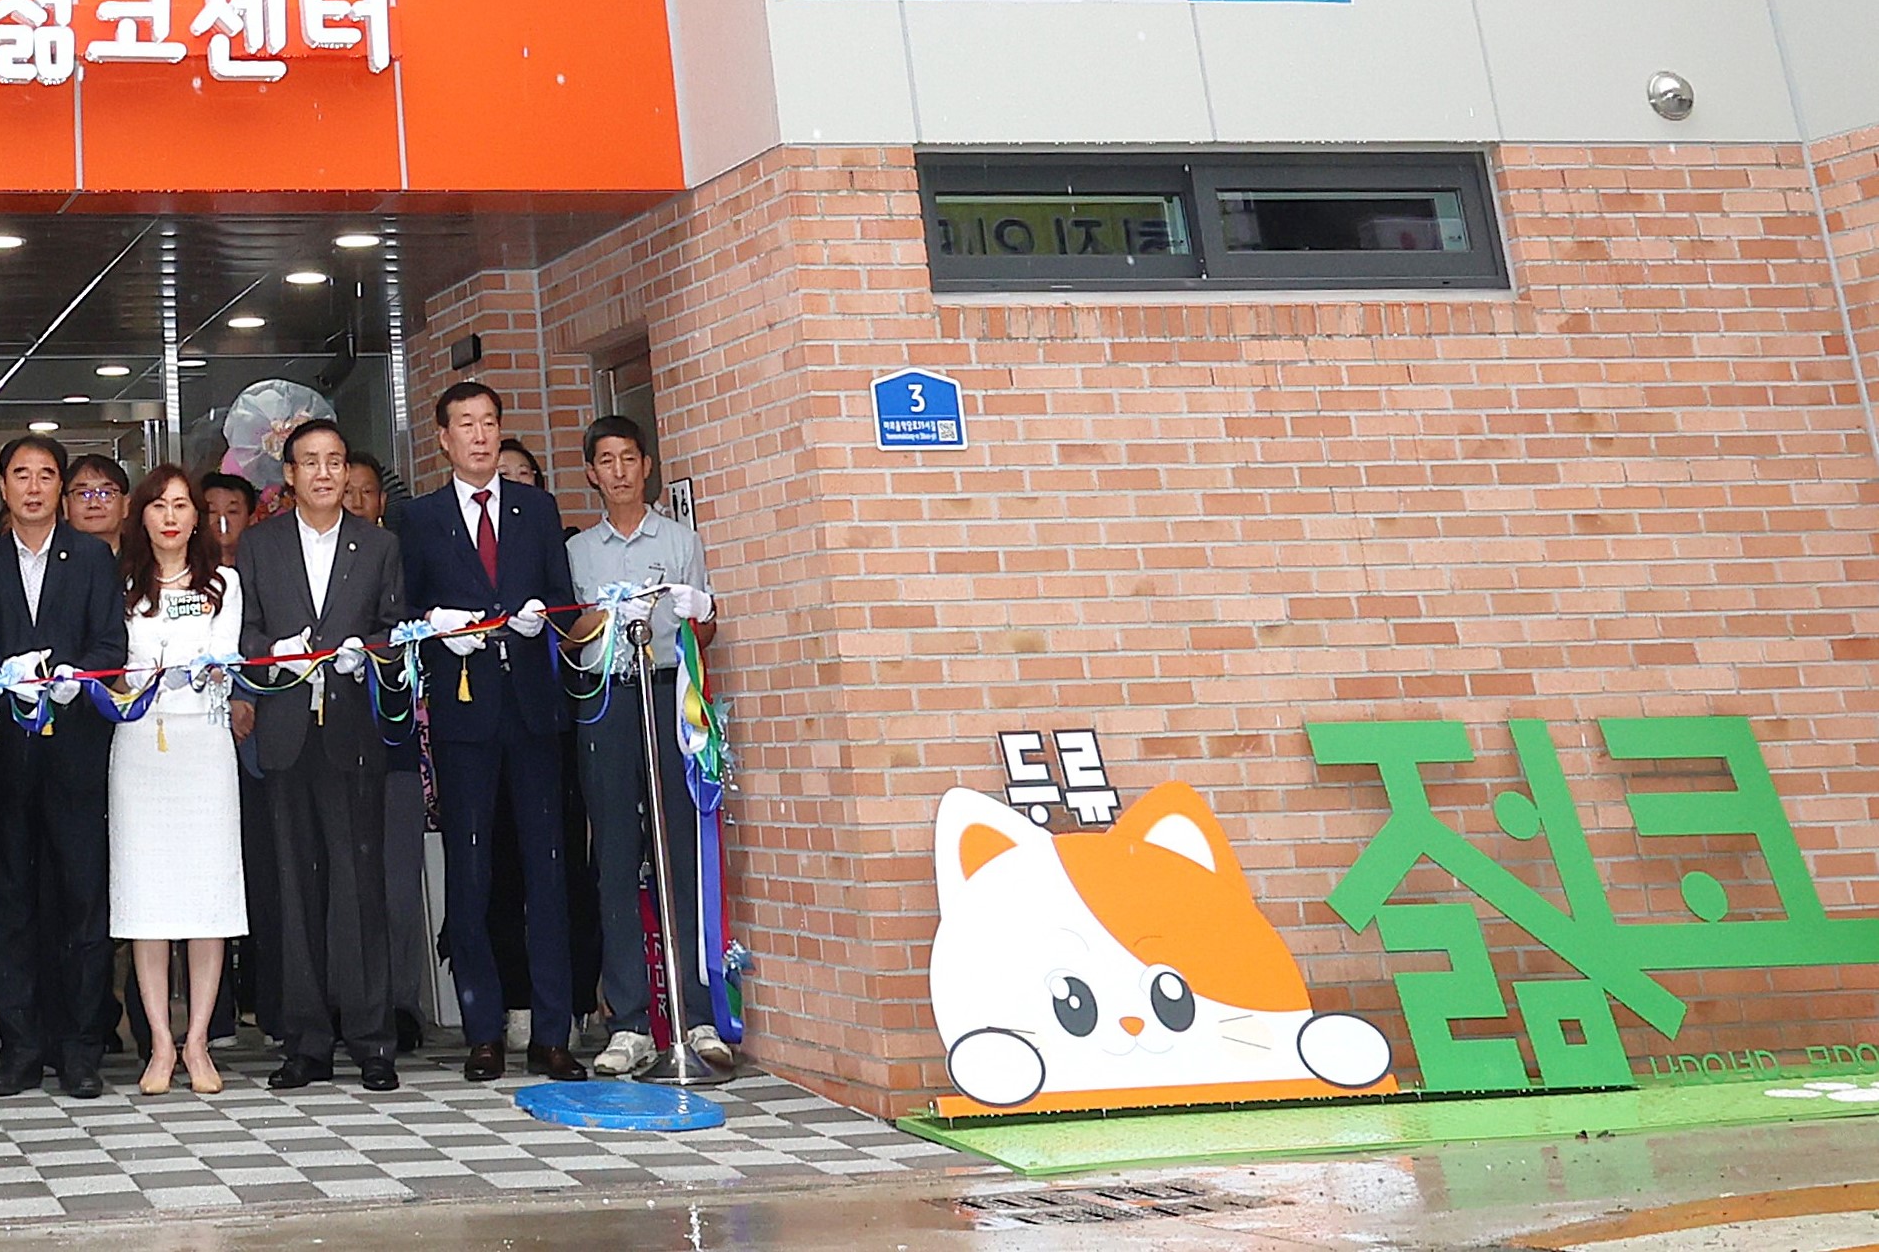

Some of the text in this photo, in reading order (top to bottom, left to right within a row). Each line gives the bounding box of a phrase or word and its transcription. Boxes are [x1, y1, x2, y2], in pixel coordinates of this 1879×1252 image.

[908, 384, 926, 413] 3
[998, 729, 1120, 826] 두류
[1306, 716, 1879, 1091] 젊코
